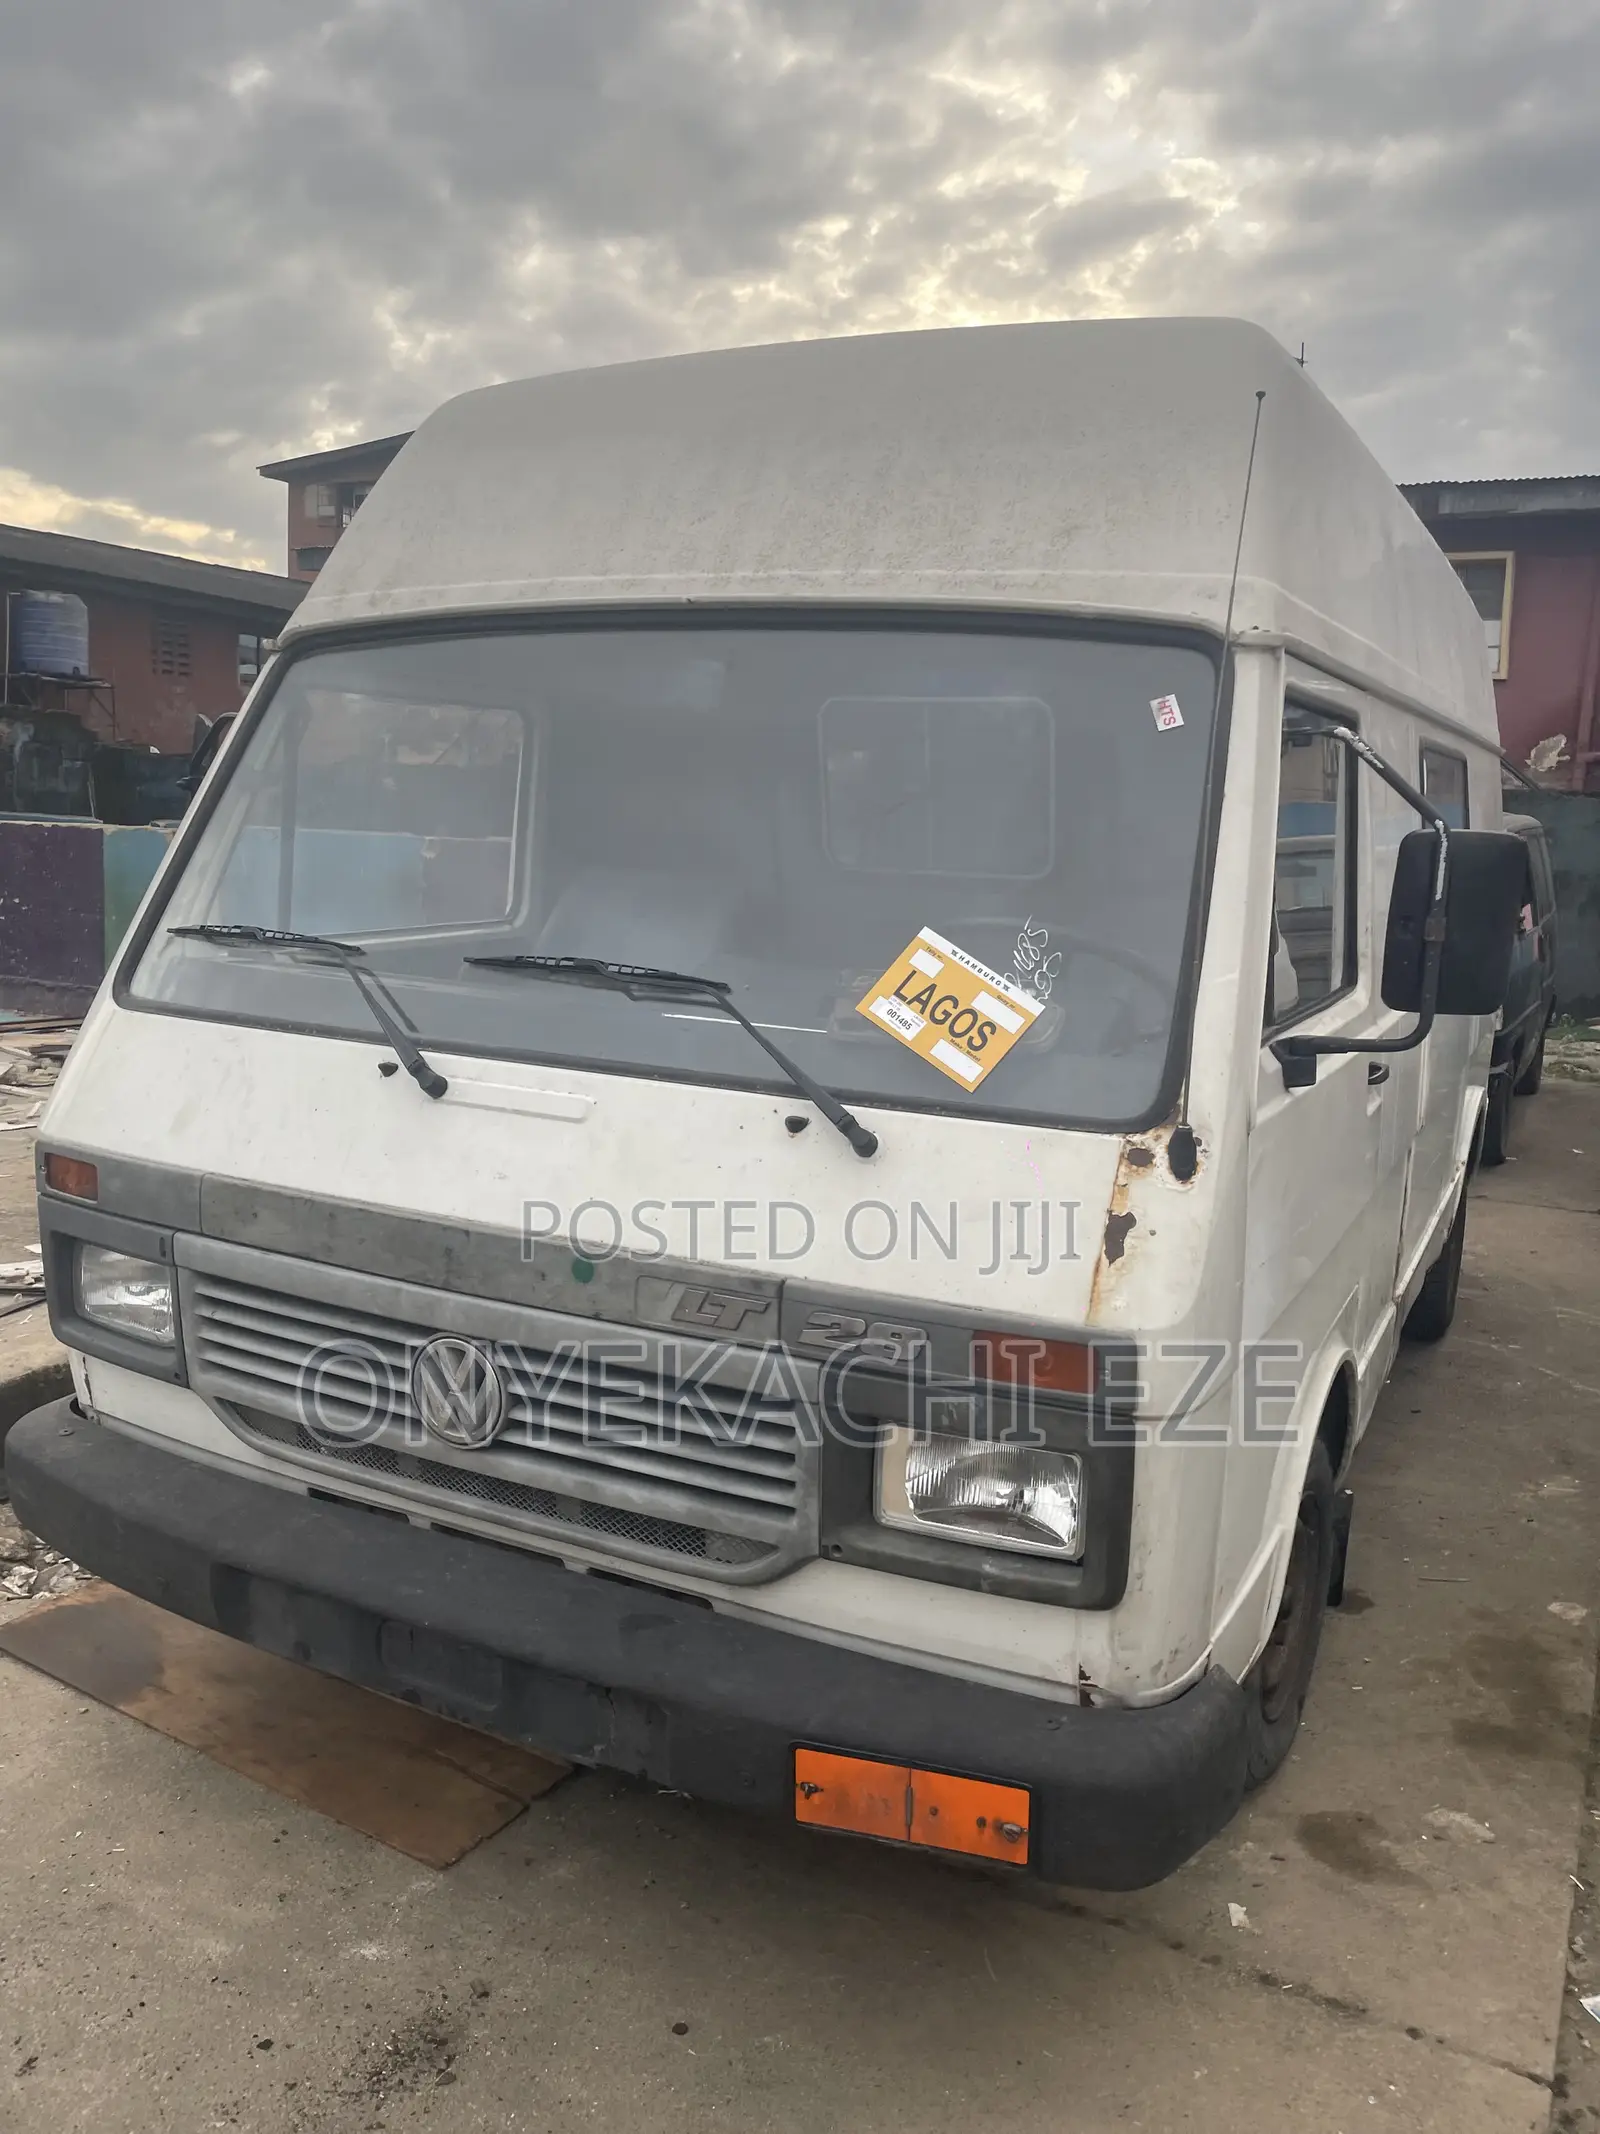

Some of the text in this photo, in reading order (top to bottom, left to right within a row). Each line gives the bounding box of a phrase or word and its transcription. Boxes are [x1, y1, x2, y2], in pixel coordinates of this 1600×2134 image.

[958, 955, 1001, 987] HAMBURG
[887, 1008, 913, 1030] 001485
[893, 969, 997, 1052] LAGOS
[670, 1287, 771, 1331] LT
